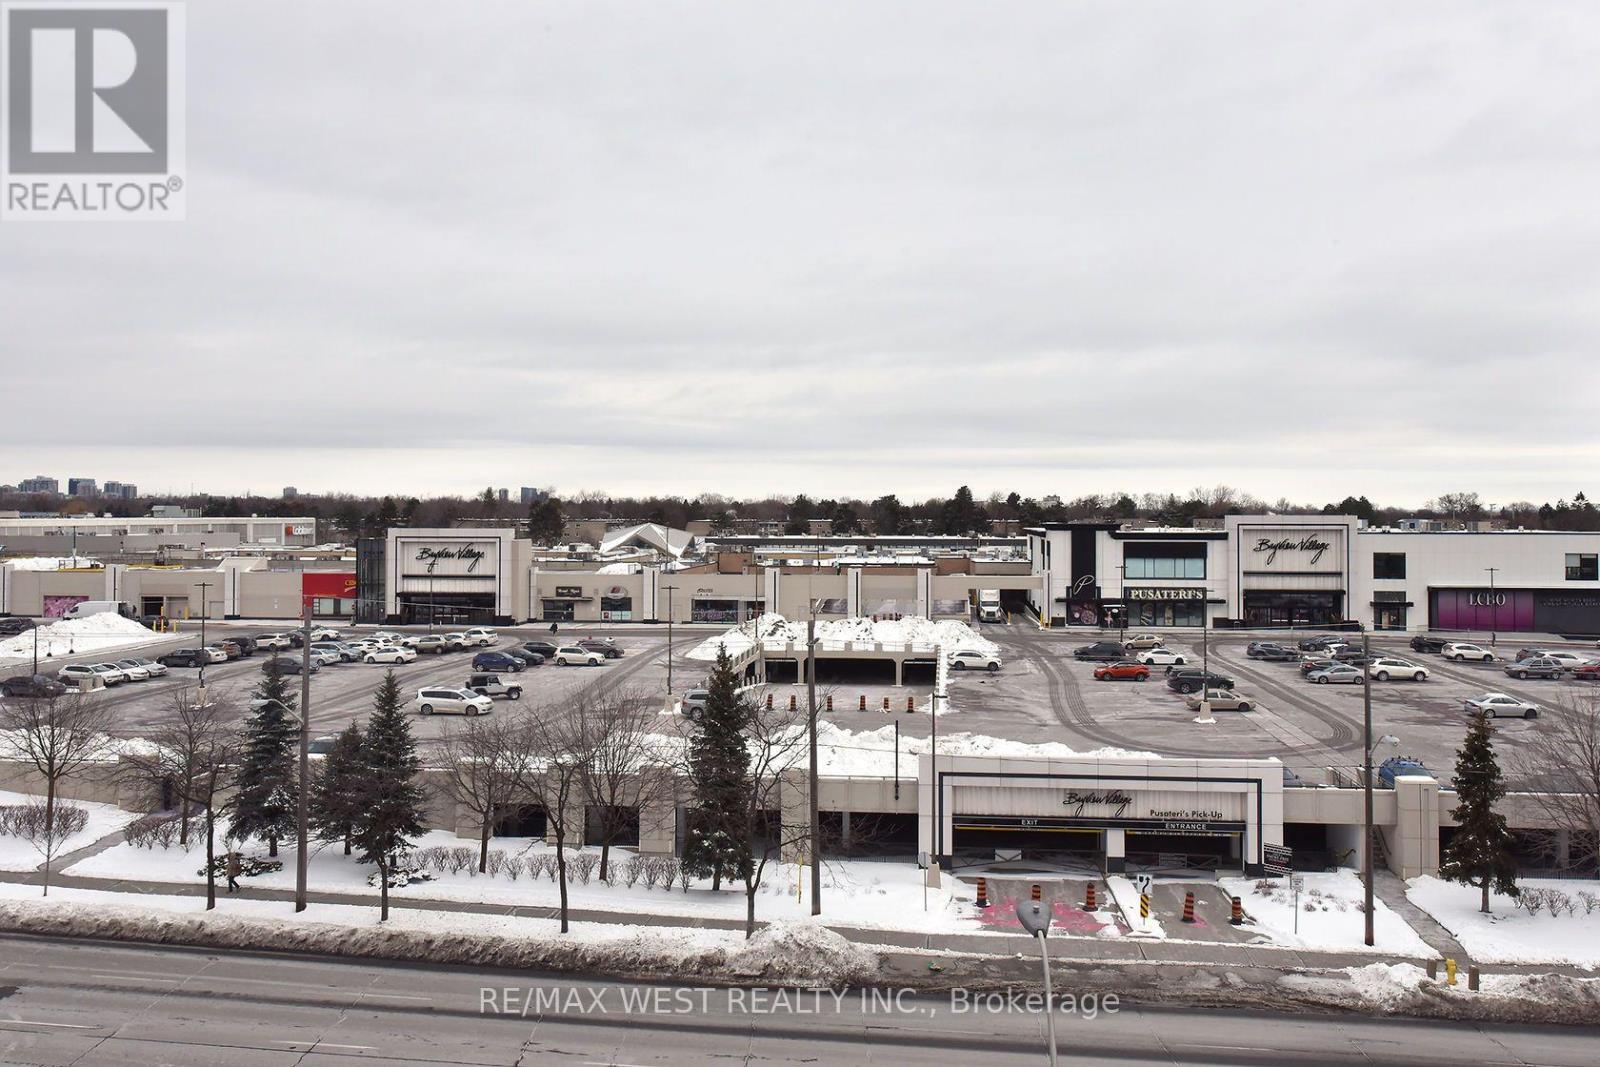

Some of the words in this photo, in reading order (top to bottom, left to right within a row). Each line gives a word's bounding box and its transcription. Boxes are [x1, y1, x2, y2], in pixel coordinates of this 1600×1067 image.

[1253, 538, 1298, 565] Bayview
[1298, 533, 1330, 564] Village
[415, 547, 457, 573] Bayview
[456, 542, 485, 573] Village
[1130, 589, 1204, 600] PUSATERI'S
[1469, 592, 1506, 606] LCBO
[1062, 792, 1104, 818] Bayview
[1103, 790, 1133, 817] Village
[1149, 809, 1189, 818] Pusateri's
[1191, 810, 1223, 819] Pick-Up
[1164, 822, 1208, 831] ENTRANCE
